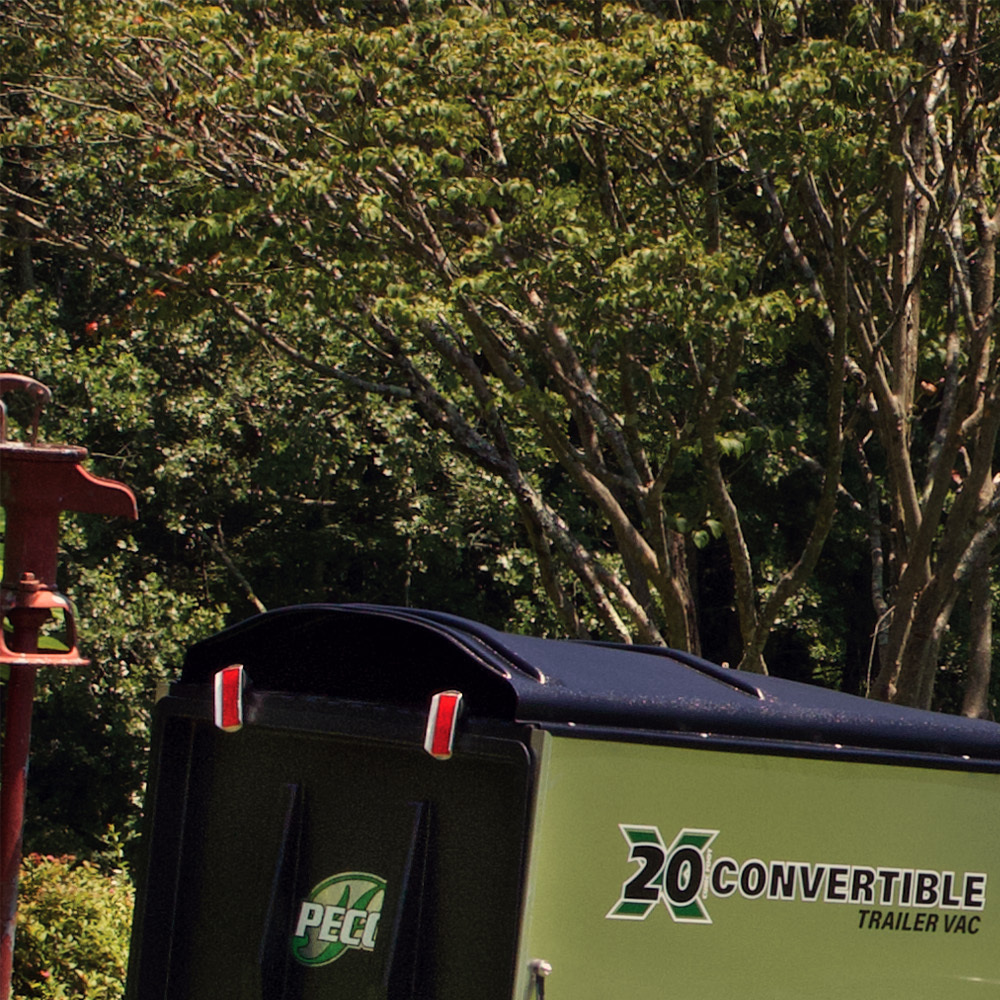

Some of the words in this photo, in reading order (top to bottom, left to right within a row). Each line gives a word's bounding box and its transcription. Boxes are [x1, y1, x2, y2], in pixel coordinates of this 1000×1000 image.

[711, 857, 987, 910] CONVERTIBLE
[858, 910, 939, 933] TRAILER
[944, 915, 981, 934] VAC
